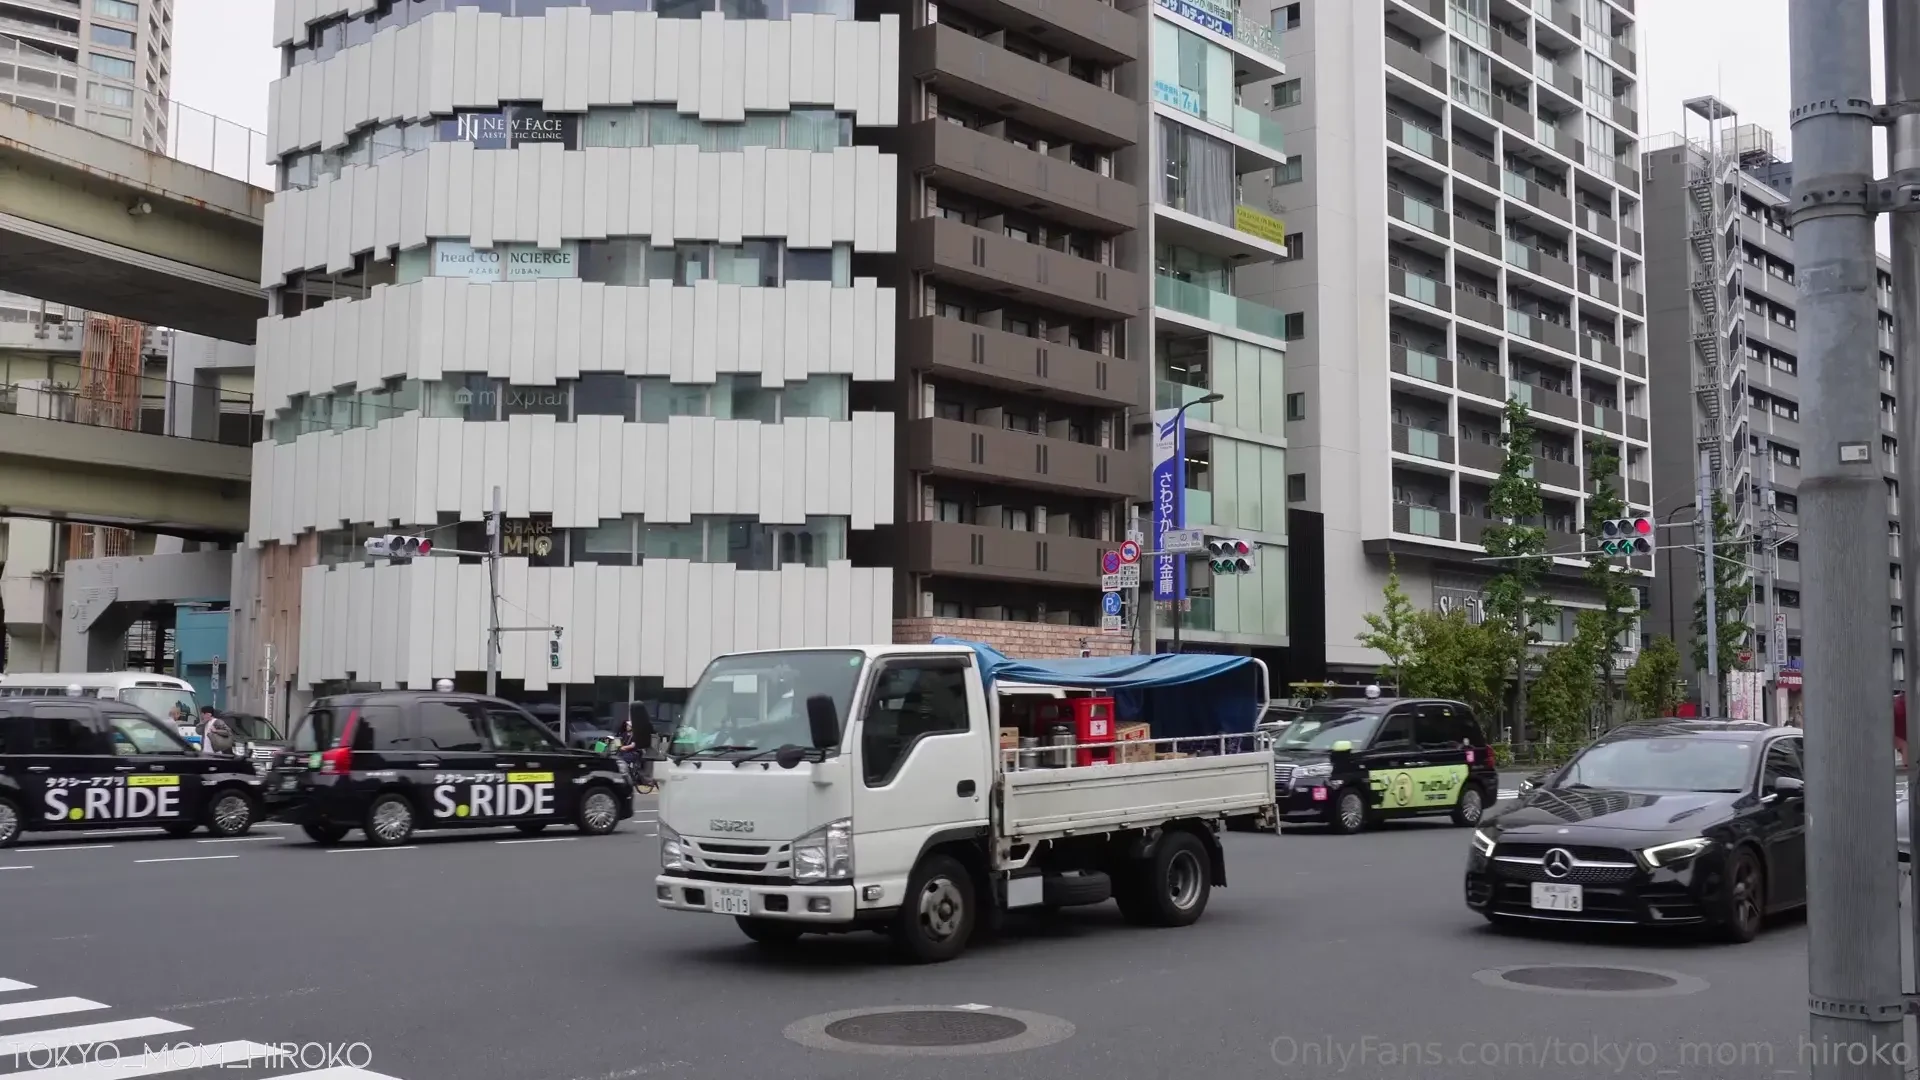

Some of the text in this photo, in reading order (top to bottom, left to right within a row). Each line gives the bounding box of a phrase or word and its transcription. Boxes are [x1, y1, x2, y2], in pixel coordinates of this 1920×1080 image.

[525, 118, 562, 131] FACE
[531, 131, 562, 139] CLINIC
[441, 252, 475, 263] head
[504, 521, 552, 534] SHARE
[1160, 472, 1173, 595] さわやか用金庫
[1106, 597, 1114, 612] P
[45, 776, 125, 788] タクシーアプリ
[434, 773, 506, 784] タクシーアプリ
[44, 786, 181, 821] S.RIDE
[433, 783, 555, 818] S.RIDE
[710, 819, 754, 833] ISUZU
